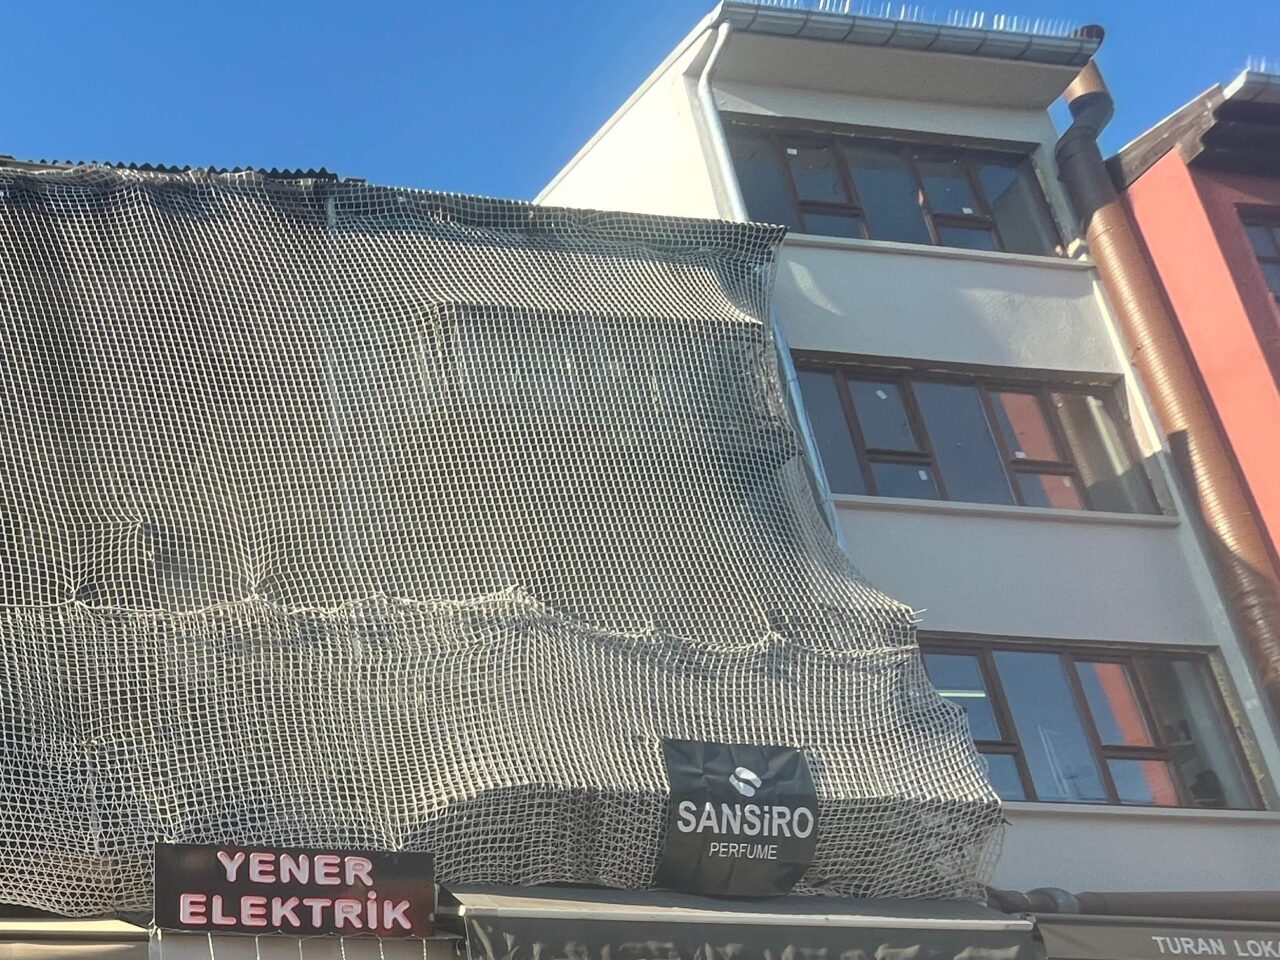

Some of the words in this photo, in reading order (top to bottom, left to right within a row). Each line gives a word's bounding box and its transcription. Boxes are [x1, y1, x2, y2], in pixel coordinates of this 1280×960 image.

[708, 842, 778, 860] PERFUME
[216, 850, 374, 887] YENER
[179, 890, 412, 931] ELEKTRİK
[1151, 936, 1226, 956] TURAN
[1233, 939, 1280, 958] LOK
